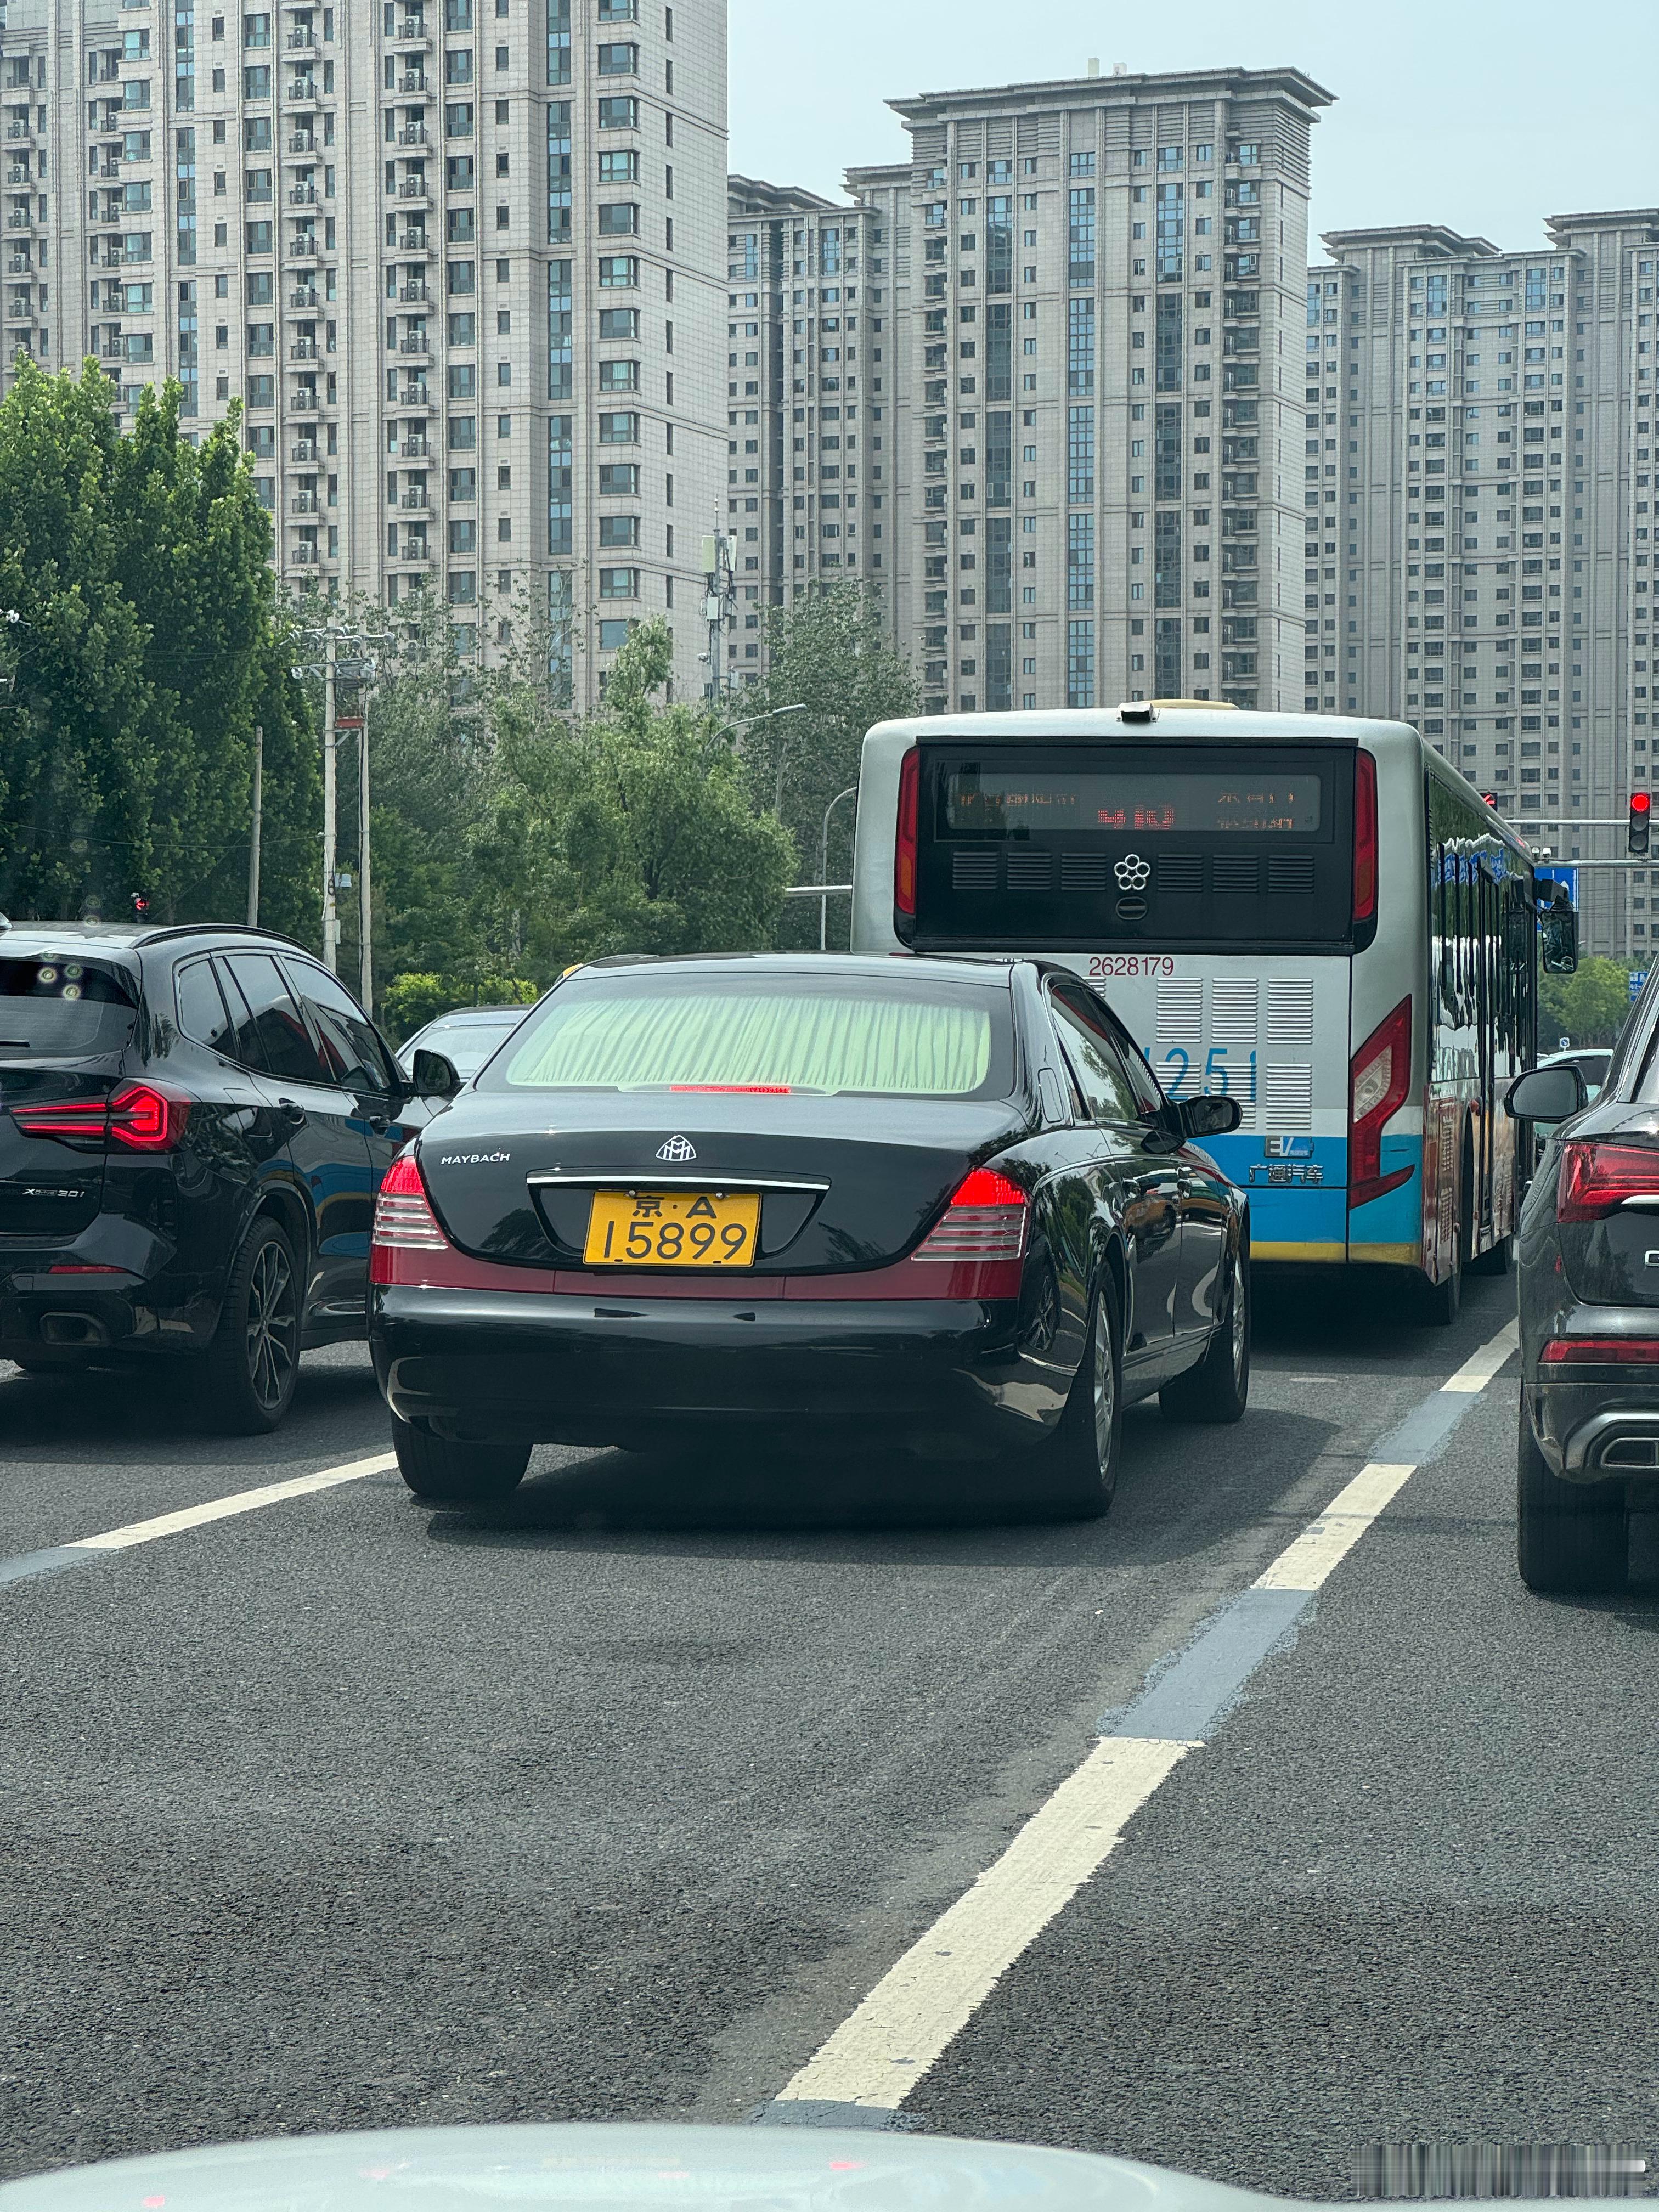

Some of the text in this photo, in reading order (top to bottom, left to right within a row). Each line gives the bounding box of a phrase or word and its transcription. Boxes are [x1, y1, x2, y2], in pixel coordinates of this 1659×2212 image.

[1089, 956, 1174, 977] 2628179
[441, 1153, 511, 1165] MAYBACH
[1249, 1164, 1324, 1184] 广通汽车
[603, 1220, 747, 1260] 15899
